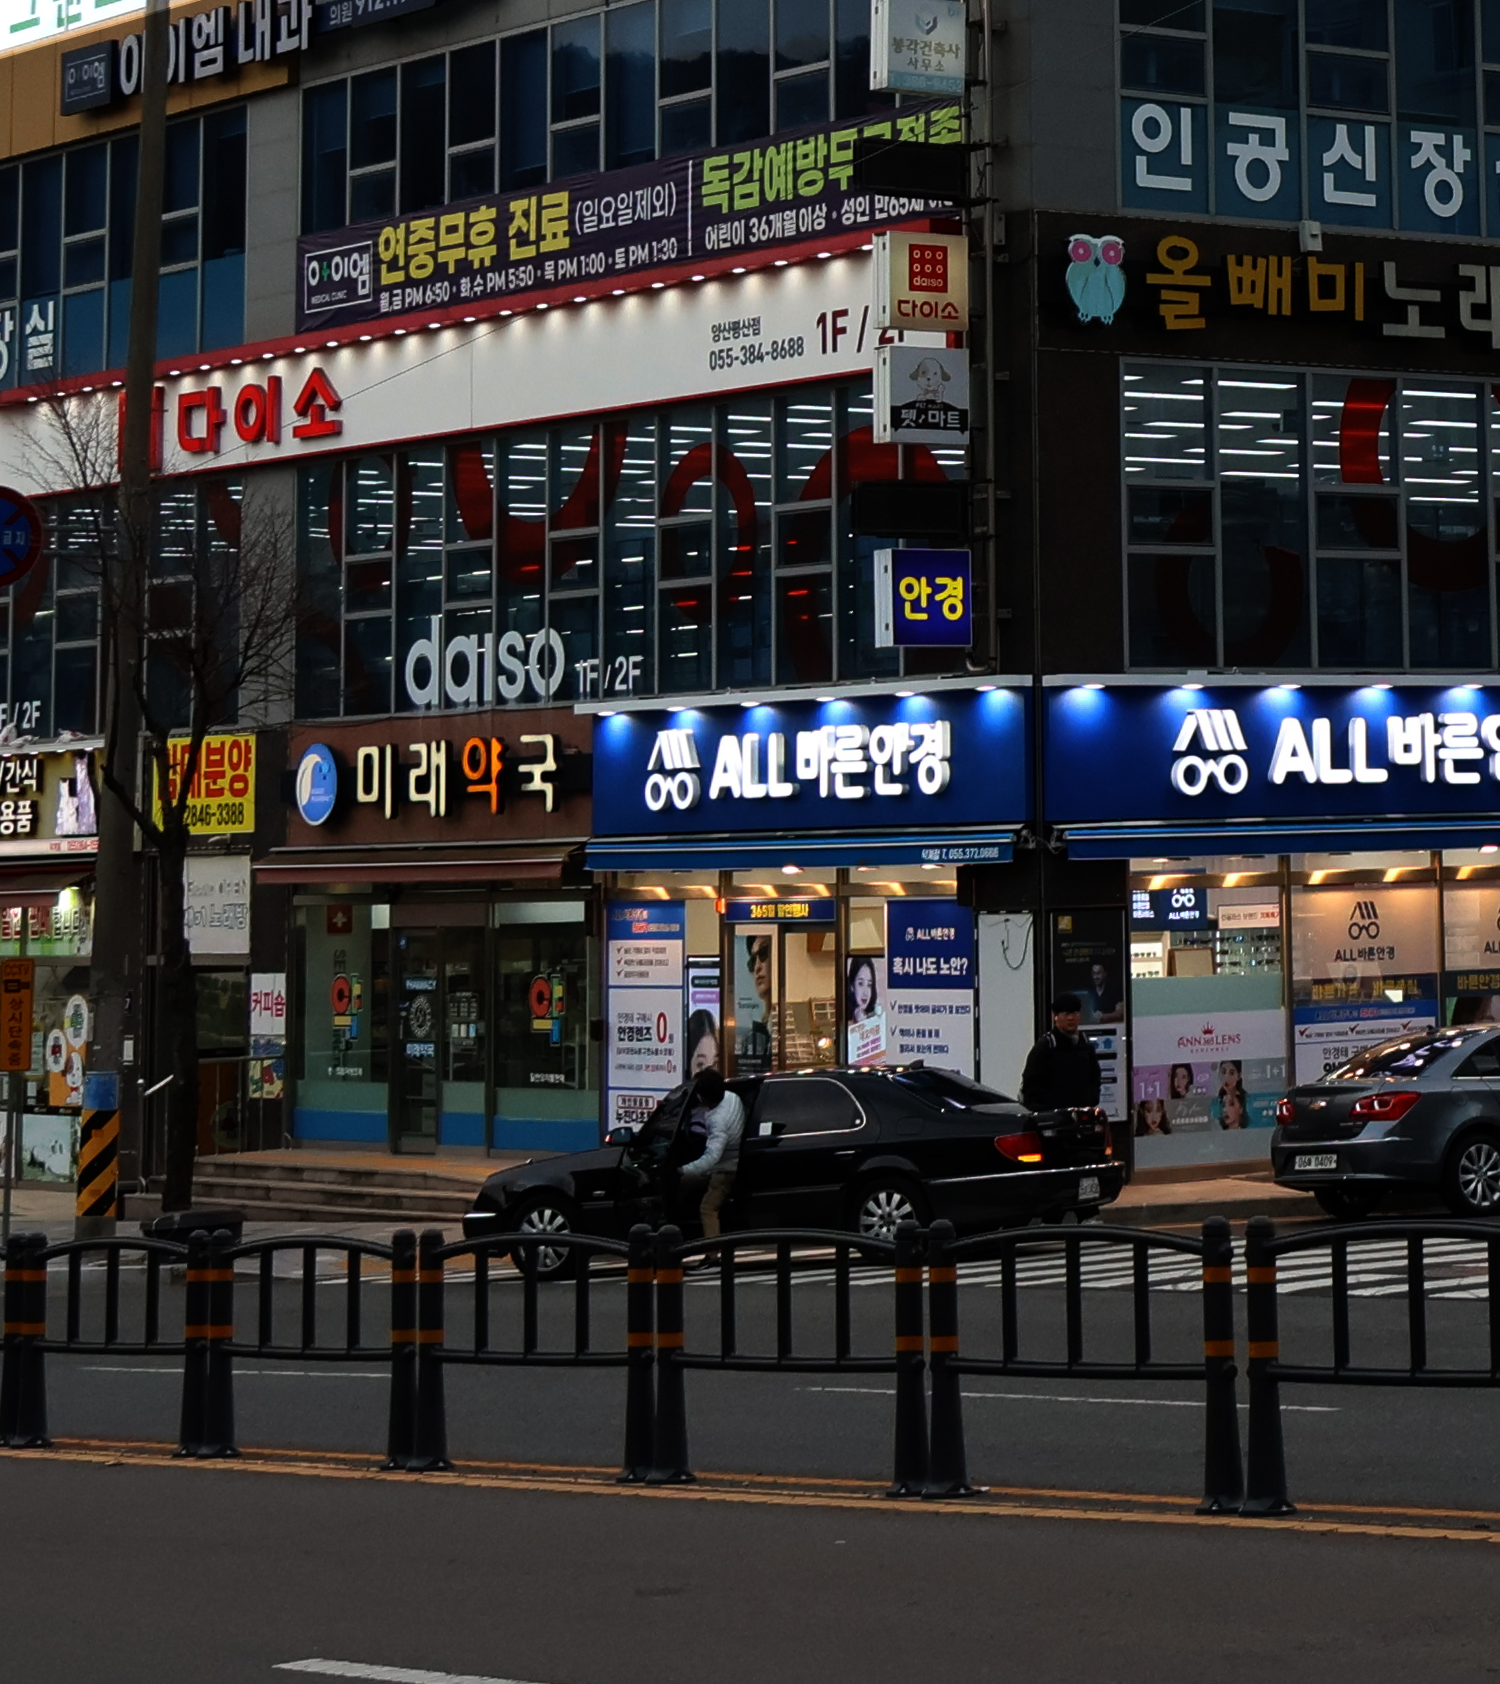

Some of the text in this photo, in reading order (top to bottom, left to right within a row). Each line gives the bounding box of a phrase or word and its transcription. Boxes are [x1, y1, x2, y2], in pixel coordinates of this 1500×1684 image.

[908, 57, 944, 72] 사무소
[379, 182, 676, 285] 연중무휴 진료 (일요일제외)
[705, 220, 745, 249] 어린이
[841, 195, 870, 224] 성인
[405, 287, 422, 308] PM
[425, 283, 450, 302] 6:50
[487, 273, 505, 293] PM
[508, 265, 534, 288] 5:50
[544, 262, 555, 281] 목
[558, 258, 577, 278] PM
[580, 253, 605, 275] 1:00
[615, 249, 625, 269] 토
[629, 244, 648, 265] PM
[652, 238, 677, 262] 1:30
[914, 275, 943, 287] daiso
[897, 300, 959, 320] 다이소
[711, 316, 761, 343] 양산평산점
[817, 309, 849, 354] 1F
[710, 337, 804, 371] 055-384-8688
[176, 366, 343, 453] 다이소
[899, 576, 964, 622] 안경
[406, 616, 642, 708] daiso 1F 2F
[22, 700, 41, 727] 2F
[357, 733, 559, 819] 미래약국
[3, 963, 30, 977] CCTV
[893, 957, 968, 976] 혹시 나도 노안?
[1457, 974, 1500, 989] 바른안경
[251, 990, 286, 1016] 커피숍
